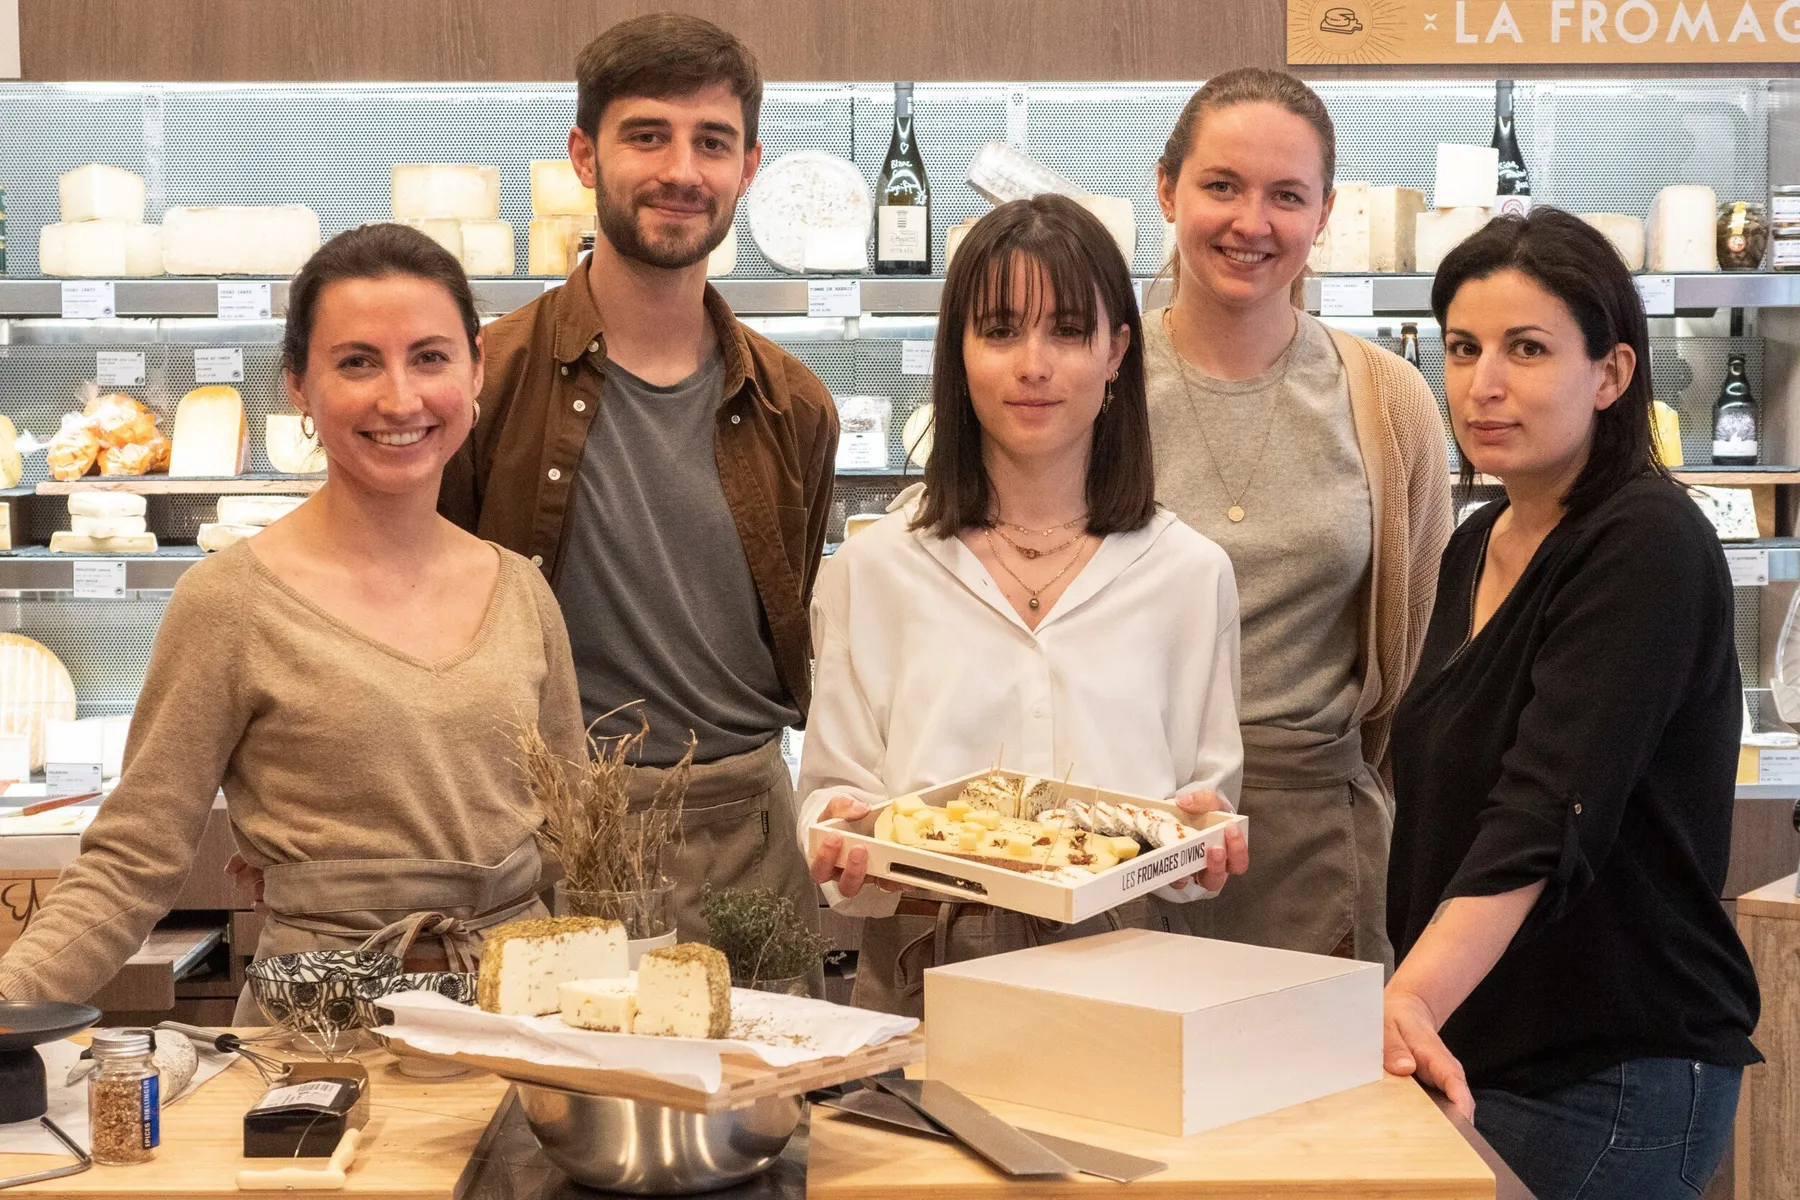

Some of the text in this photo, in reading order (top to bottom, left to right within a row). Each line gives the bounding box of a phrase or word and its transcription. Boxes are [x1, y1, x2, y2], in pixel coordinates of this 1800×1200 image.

[1455, 0, 1800, 44] LA FROMAG
[1121, 842, 1206, 891] LES FROMAGES DIVINS
